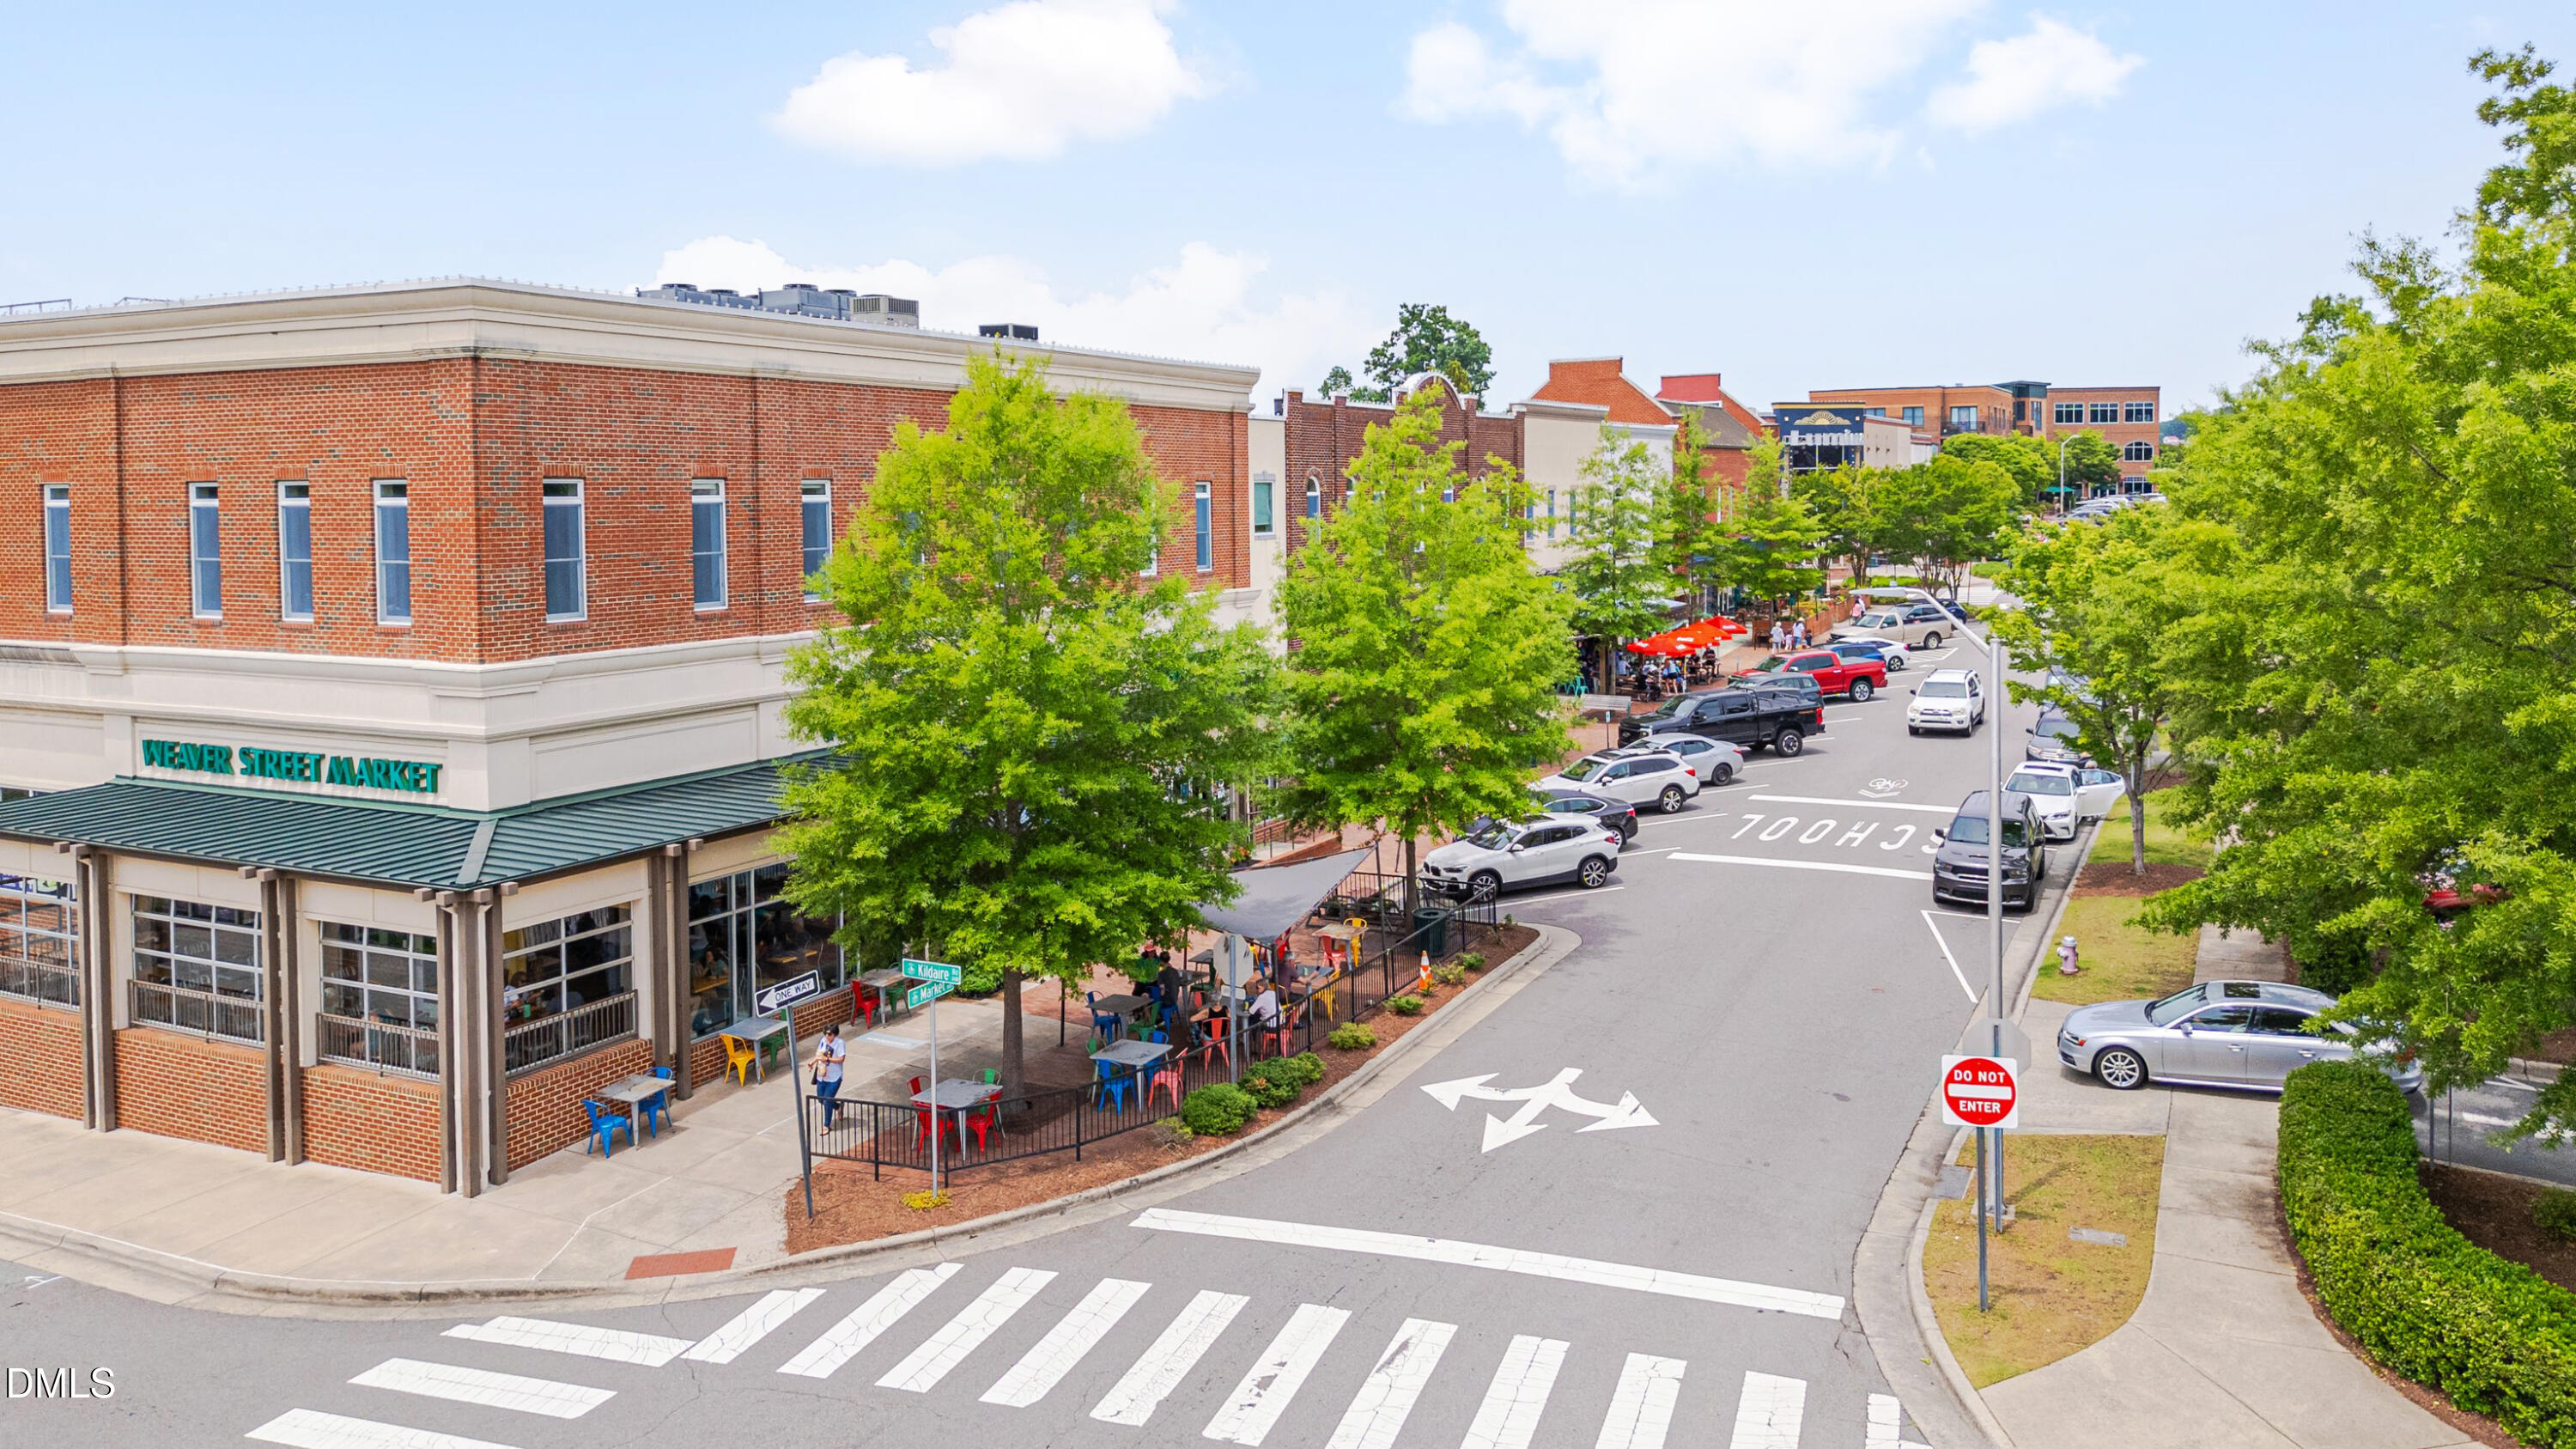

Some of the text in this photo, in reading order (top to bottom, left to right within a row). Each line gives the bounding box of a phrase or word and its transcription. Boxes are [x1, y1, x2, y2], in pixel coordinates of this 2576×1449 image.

[143, 740, 444, 794] WEAVER STREET MARKET
[918, 964, 950, 980] Kildaire
[775, 979, 811, 1002] ONE WAY
[920, 983, 945, 1001] Market
[1953, 1069, 2006, 1084] DO NOT
[1959, 1100, 2002, 1114] ENTER
